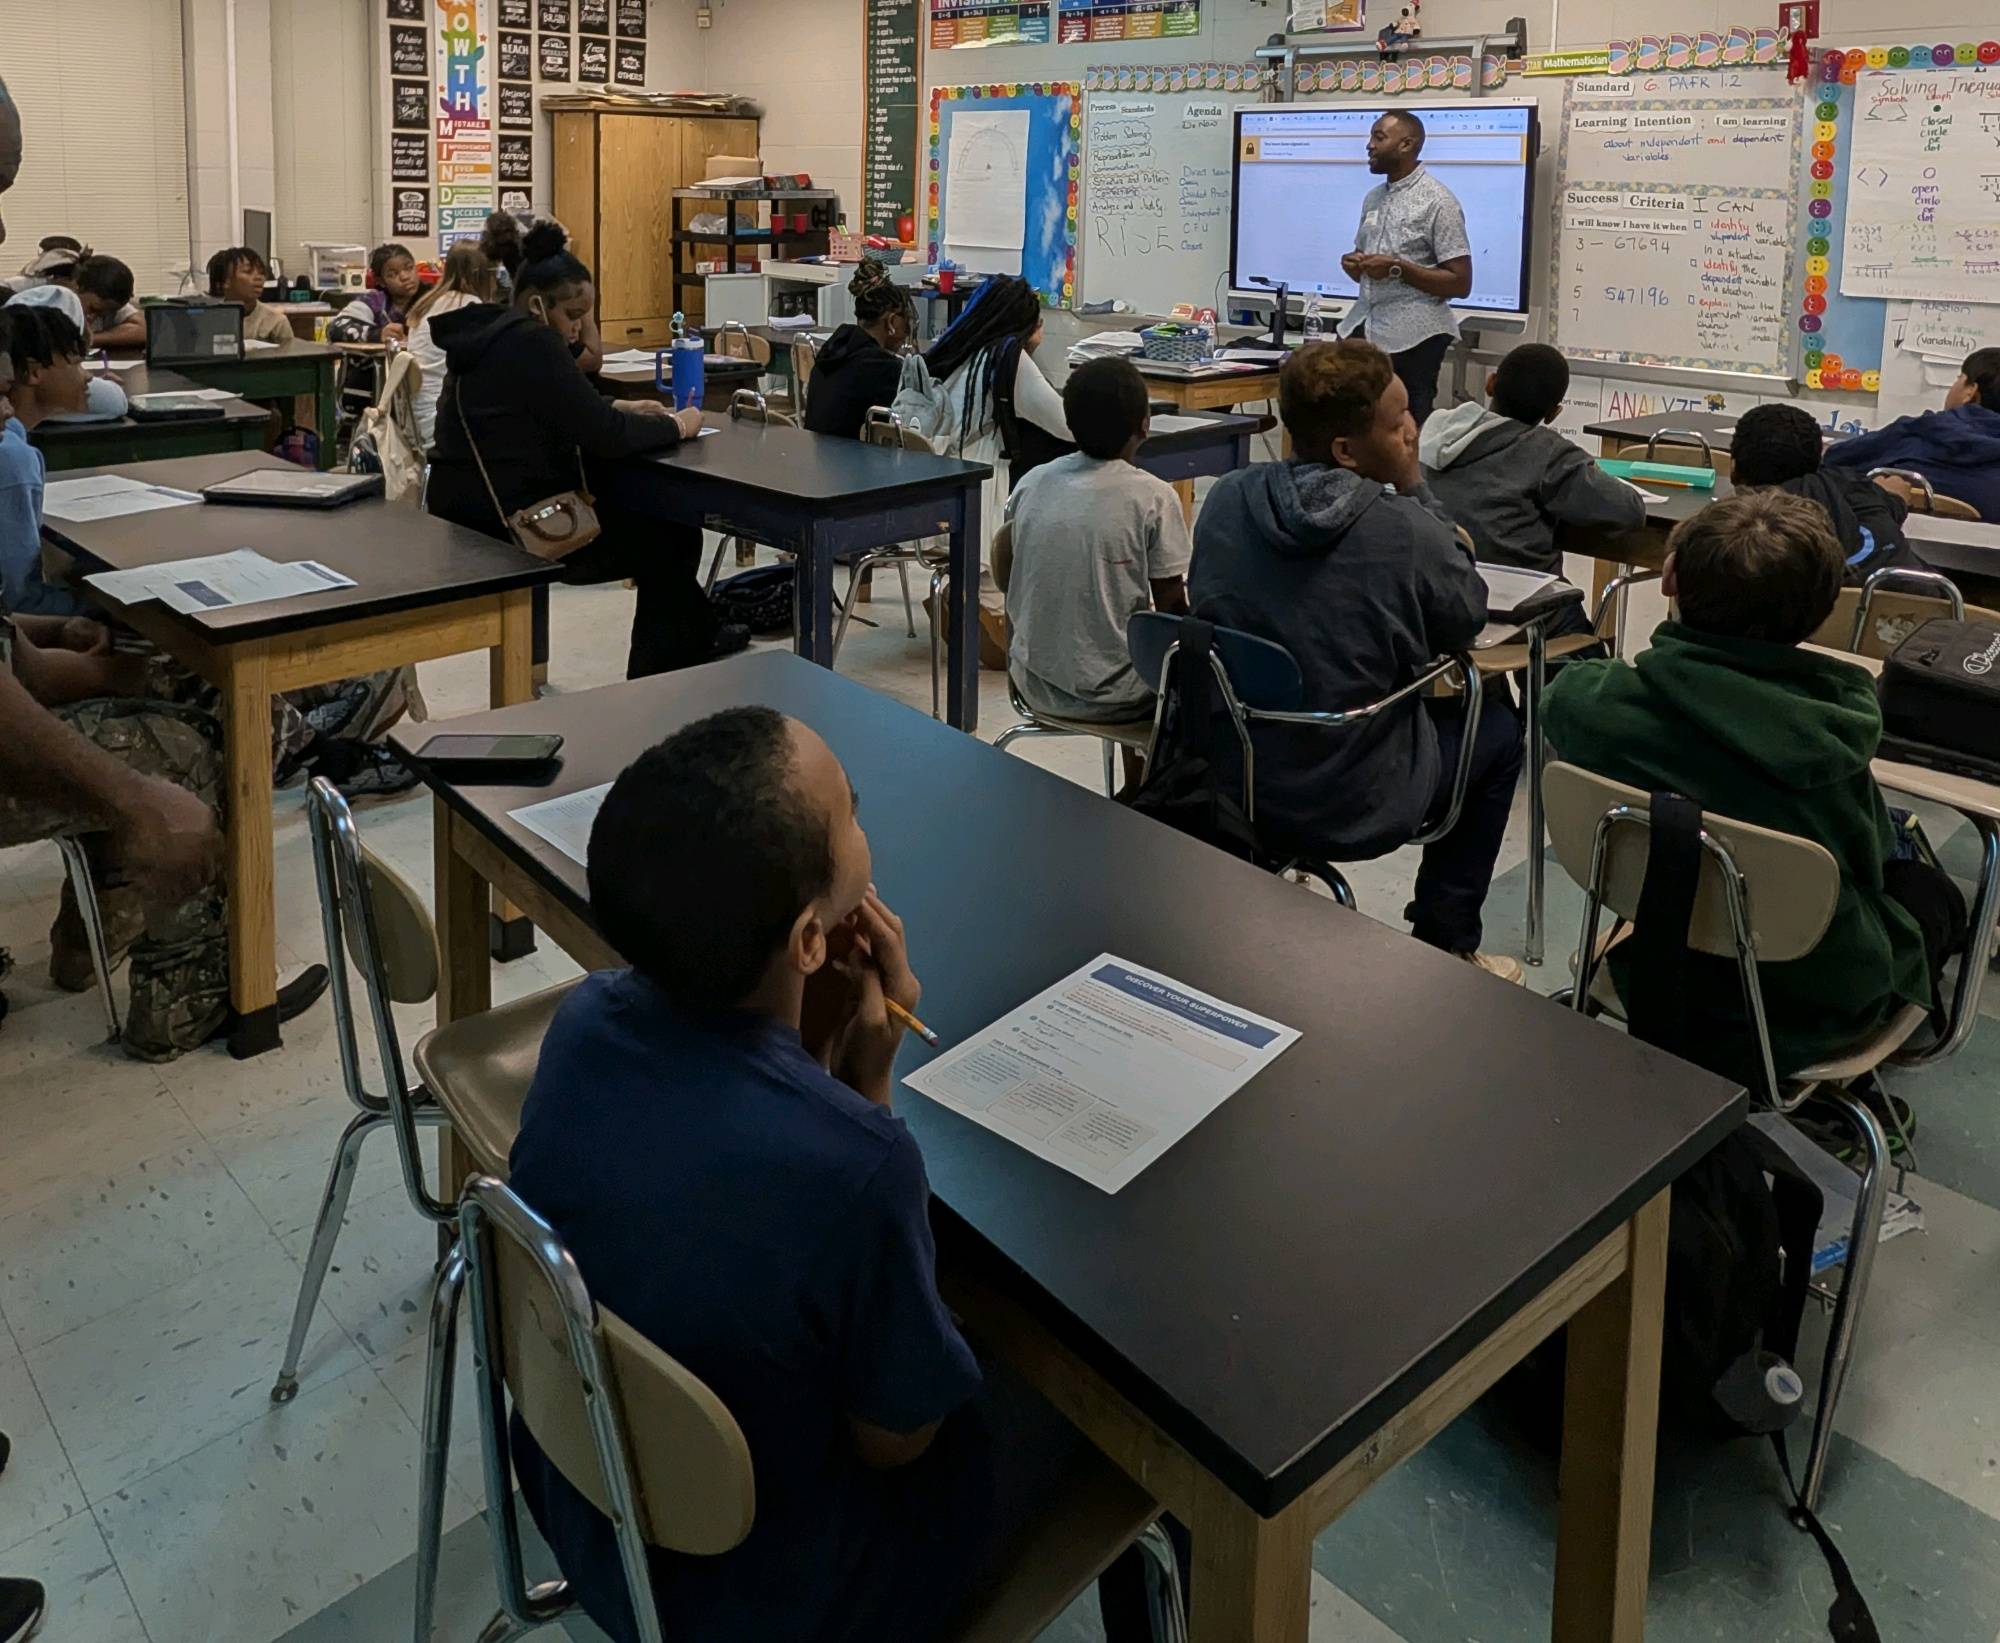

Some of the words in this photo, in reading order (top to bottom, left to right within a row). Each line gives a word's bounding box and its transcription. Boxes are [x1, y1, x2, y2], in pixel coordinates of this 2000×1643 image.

[502, 44, 528, 55] REACH
[1544, 56, 1608, 68] Mathematician
[618, 71, 643, 81] OTHERS
[1576, 82, 1630, 92] Standard
[1880, 78, 1938, 96] Solving
[1187, 106, 1222, 117] Agenda
[1575, 118, 1628, 128] Learning
[1634, 116, 1691, 127] Intention
[1716, 117, 1720, 125] I
[1743, 117, 1786, 126] learning
[1604, 136, 1633, 148] about
[1707, 136, 1726, 145] and
[1733, 133, 1785, 148] dependent
[1912, 185, 1939, 198] open
[1567, 193, 1619, 204] Success
[1630, 195, 1685, 210] Criteria
[1693, 197, 1708, 213] I
[1717, 201, 1754, 212] CAN
[397, 223, 426, 231] TOUGH
[1597, 220, 1620, 228] know
[1630, 221, 1650, 229] have
[1662, 223, 1687, 231] when
[1756, 221, 1774, 234] the
[1576, 238, 1584, 250] 3
[1614, 237, 1670, 255] 67694
[1576, 262, 1584, 272] 4
[1574, 285, 1582, 298] 5
[1604, 286, 1669, 307] 547196
[1572, 308, 1579, 322] 7
[1921, 302, 1971, 316] question
[1124, 974, 1166, 994] DISCOVER
[1166, 991, 1189, 1006] YOUR
[1189, 1001, 1248, 1030] SUPERPOWER
